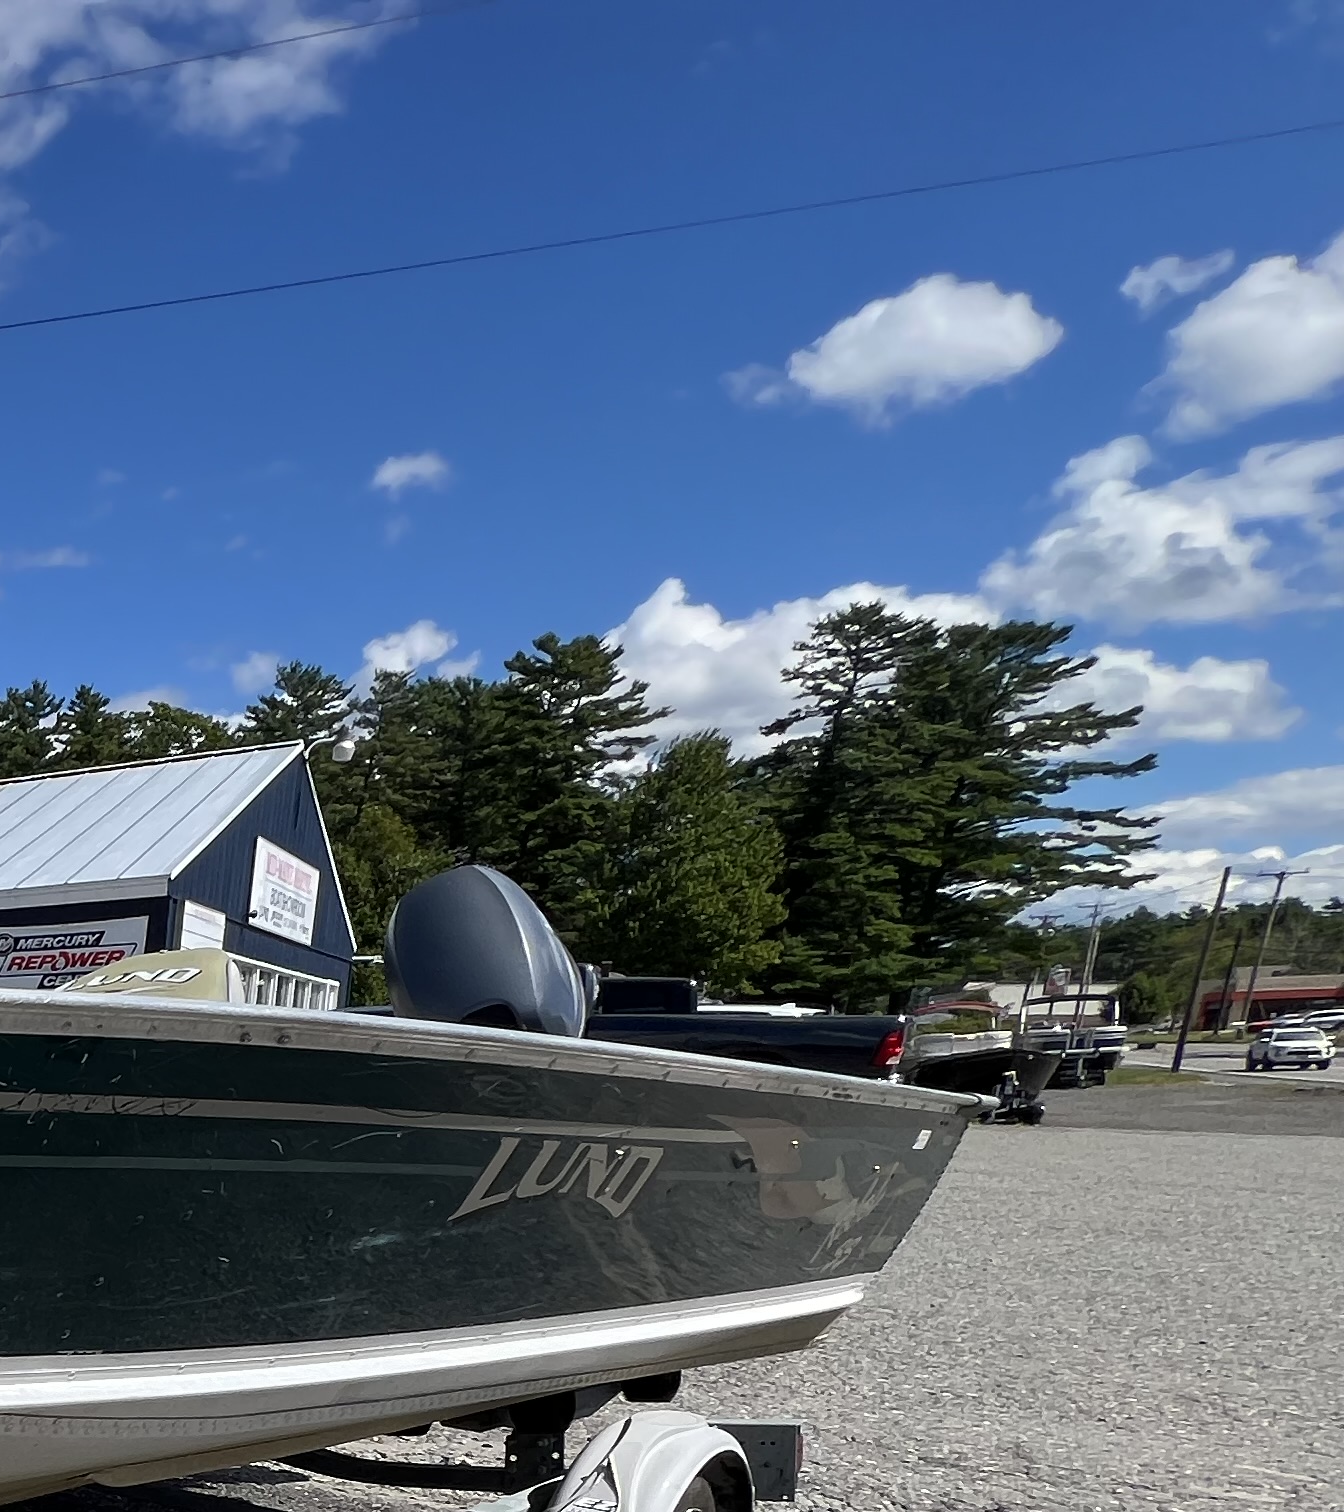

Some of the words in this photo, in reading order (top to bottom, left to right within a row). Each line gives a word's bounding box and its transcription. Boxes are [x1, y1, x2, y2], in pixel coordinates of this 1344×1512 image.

[16, 932, 99, 950] MERCURY
[6, 949, 126, 972] REPOWER
[55, 967, 203, 992] LUND
[446, 1136, 665, 1223] LUND
